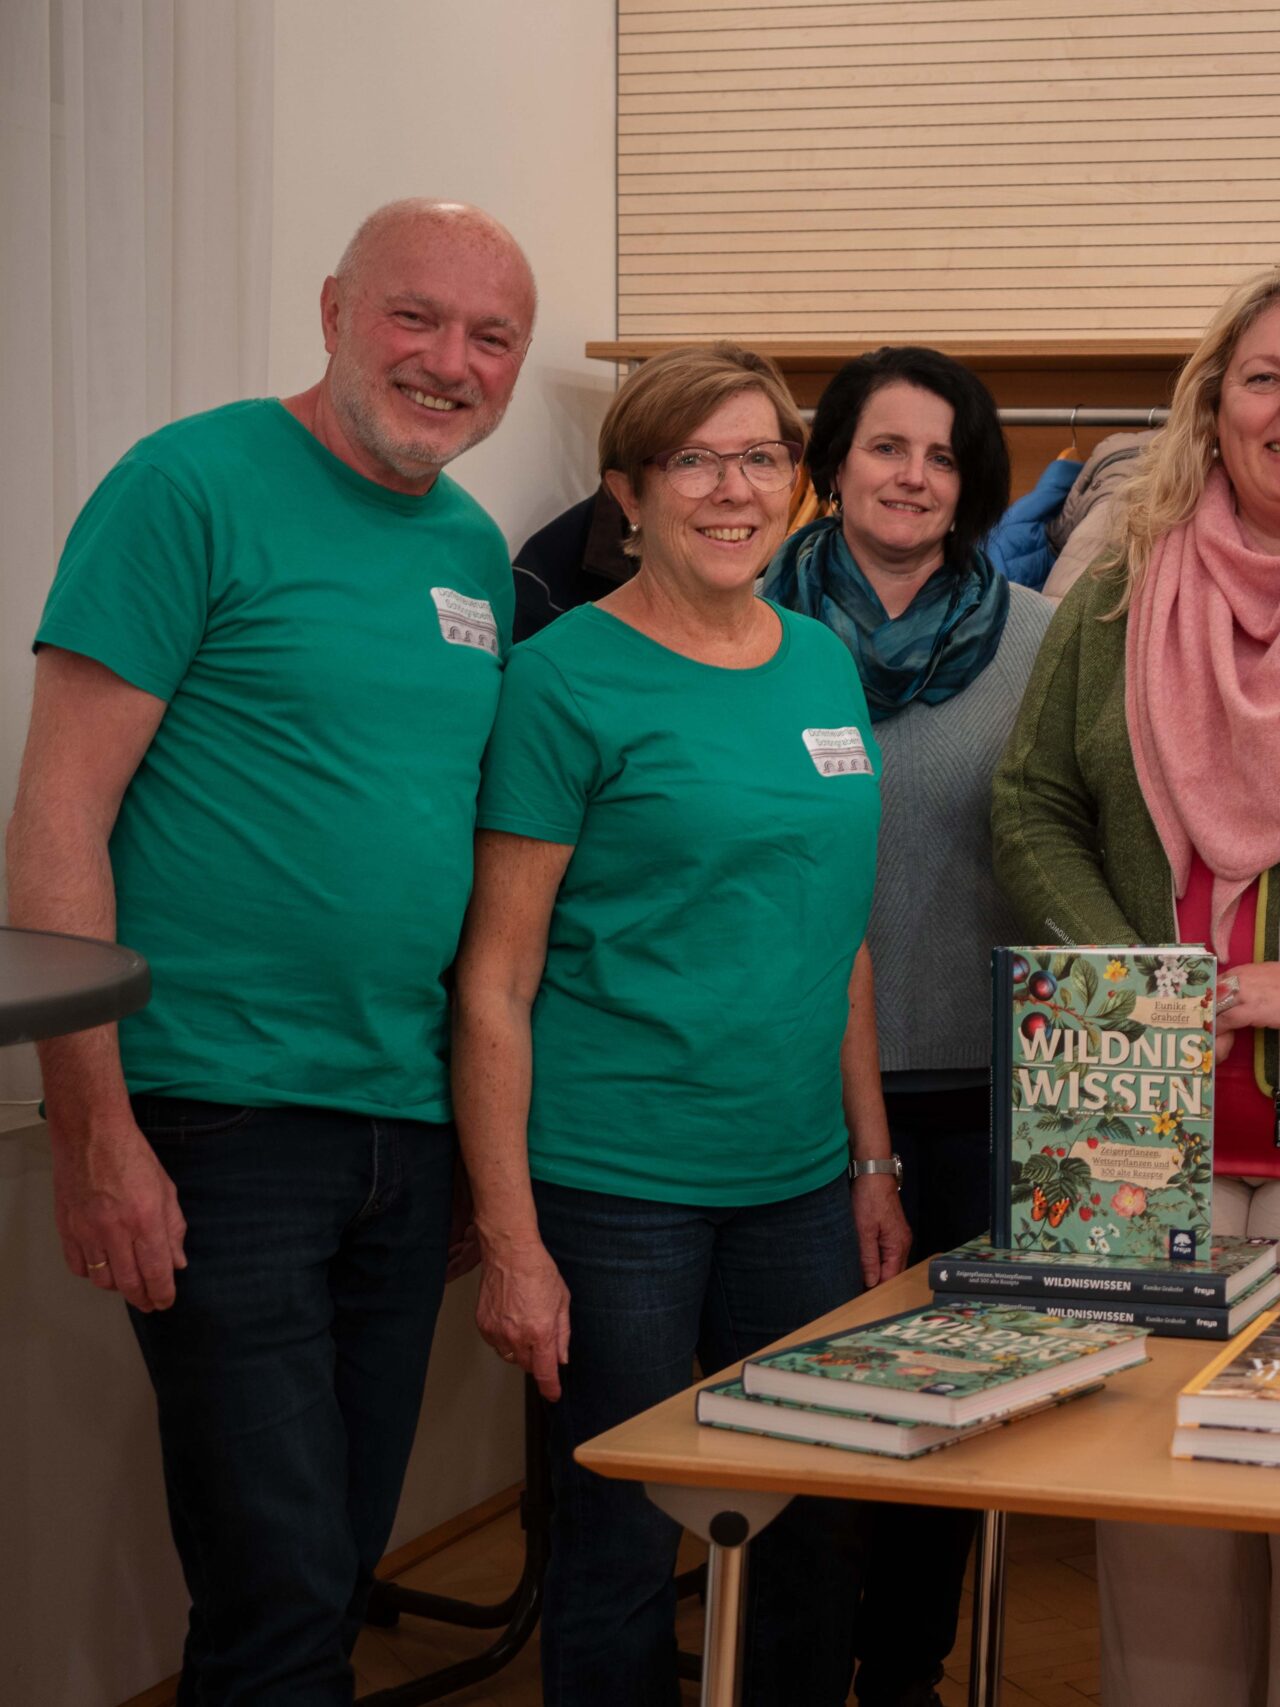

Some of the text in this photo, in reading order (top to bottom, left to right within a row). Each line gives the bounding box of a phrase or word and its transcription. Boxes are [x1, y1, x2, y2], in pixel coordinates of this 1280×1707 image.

[1154, 1000, 1187, 1010] Eunike
[1151, 1012, 1190, 1022] Grahofer
[1017, 1027, 1204, 1070] WILDNIS
[1018, 1069, 1202, 1115] WISSEN
[1100, 1147, 1161, 1158] Zeigerpflanzen,
[1092, 1156, 1152, 1168] Wetterpflanzen
[1101, 1167, 1163, 1179] 300 alte Rezepte
[1173, 1246, 1191, 1254] freya
[1043, 1276, 1131, 1291] WILDNISWISSEN
[1193, 1286, 1215, 1296] freya
[1046, 1307, 1134, 1323] WILDNISWISSEN
[1196, 1318, 1217, 1328] freya
[910, 1316, 1094, 1352] WILDNIS
[881, 1324, 1066, 1361] WISSEN
